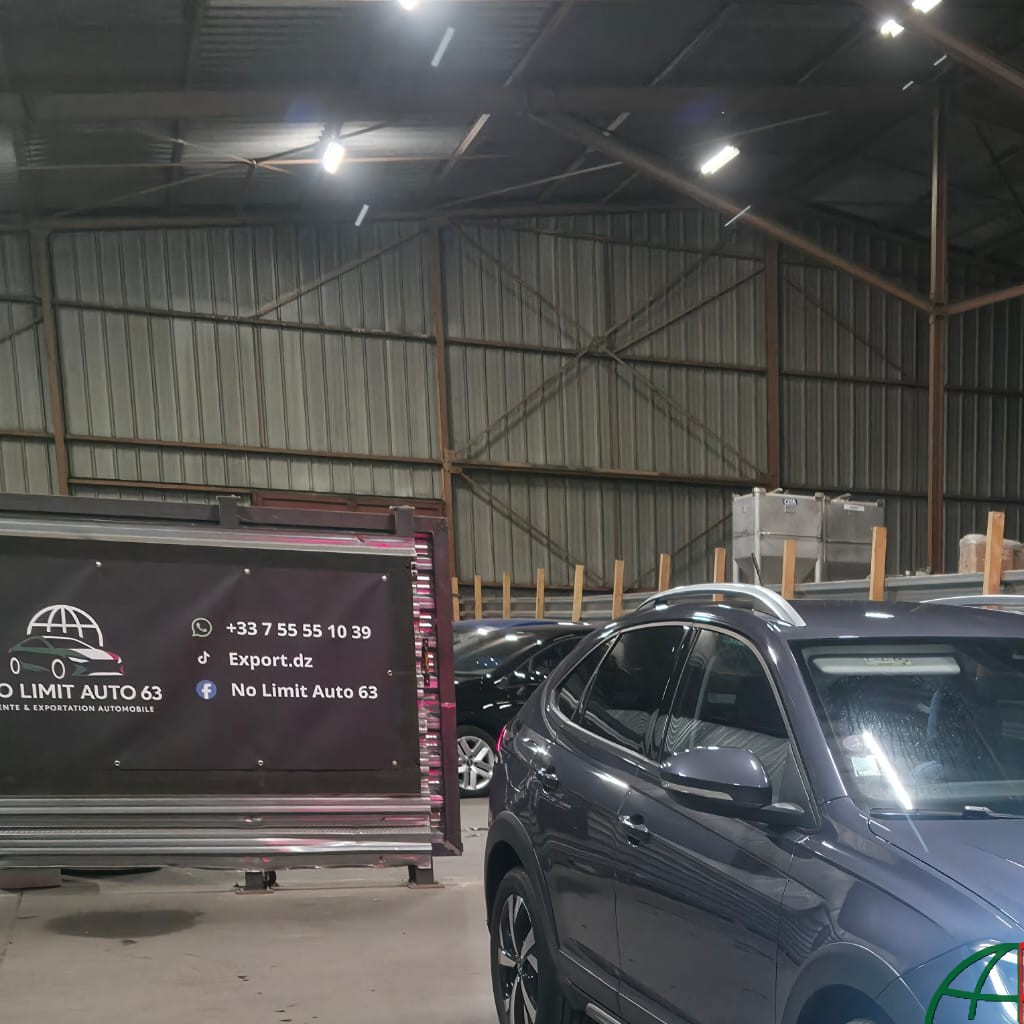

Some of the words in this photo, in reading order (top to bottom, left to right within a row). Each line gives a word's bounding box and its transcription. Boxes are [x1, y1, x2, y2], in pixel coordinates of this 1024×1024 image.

[226, 621, 258, 636] +33
[261, 621, 273, 636] 7
[277, 622, 298, 637] 55
[302, 623, 323, 638] 55
[327, 624, 347, 639] 10
[351, 625, 371, 640] 39
[228, 652, 314, 670] Export.dz
[0, 682, 14, 699] O
[19, 683, 75, 699] LIMIT
[80, 684, 137, 700] AUTO
[140, 685, 163, 701] 63
[231, 682, 257, 697] No
[262, 683, 309, 698] Limit
[311, 684, 354, 699] Auto
[358, 685, 379, 699] 63
[23, 704, 31, 712] &
[33, 704, 95, 712] EXPORTATION
[98, 705, 155, 713] AUTOMOBILE
